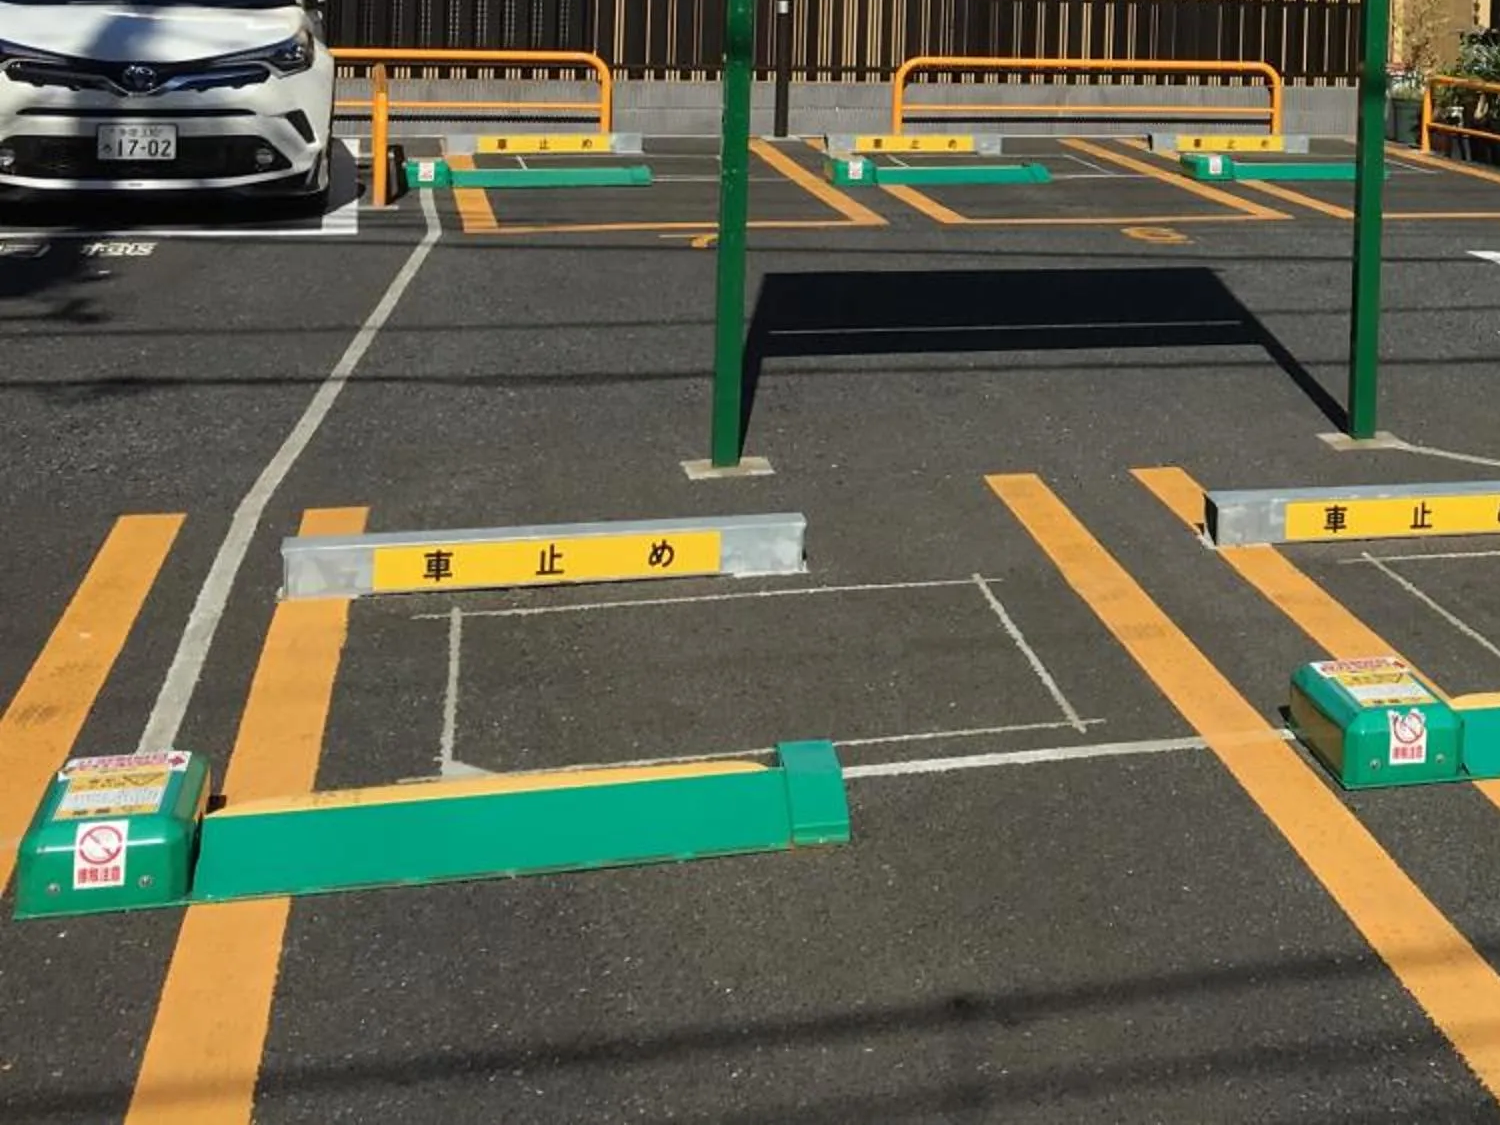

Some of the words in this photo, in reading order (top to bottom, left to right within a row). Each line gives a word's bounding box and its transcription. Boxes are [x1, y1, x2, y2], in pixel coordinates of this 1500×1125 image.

[117, 138, 172, 158] 17-02
[423, 538, 675, 582] 車止め
